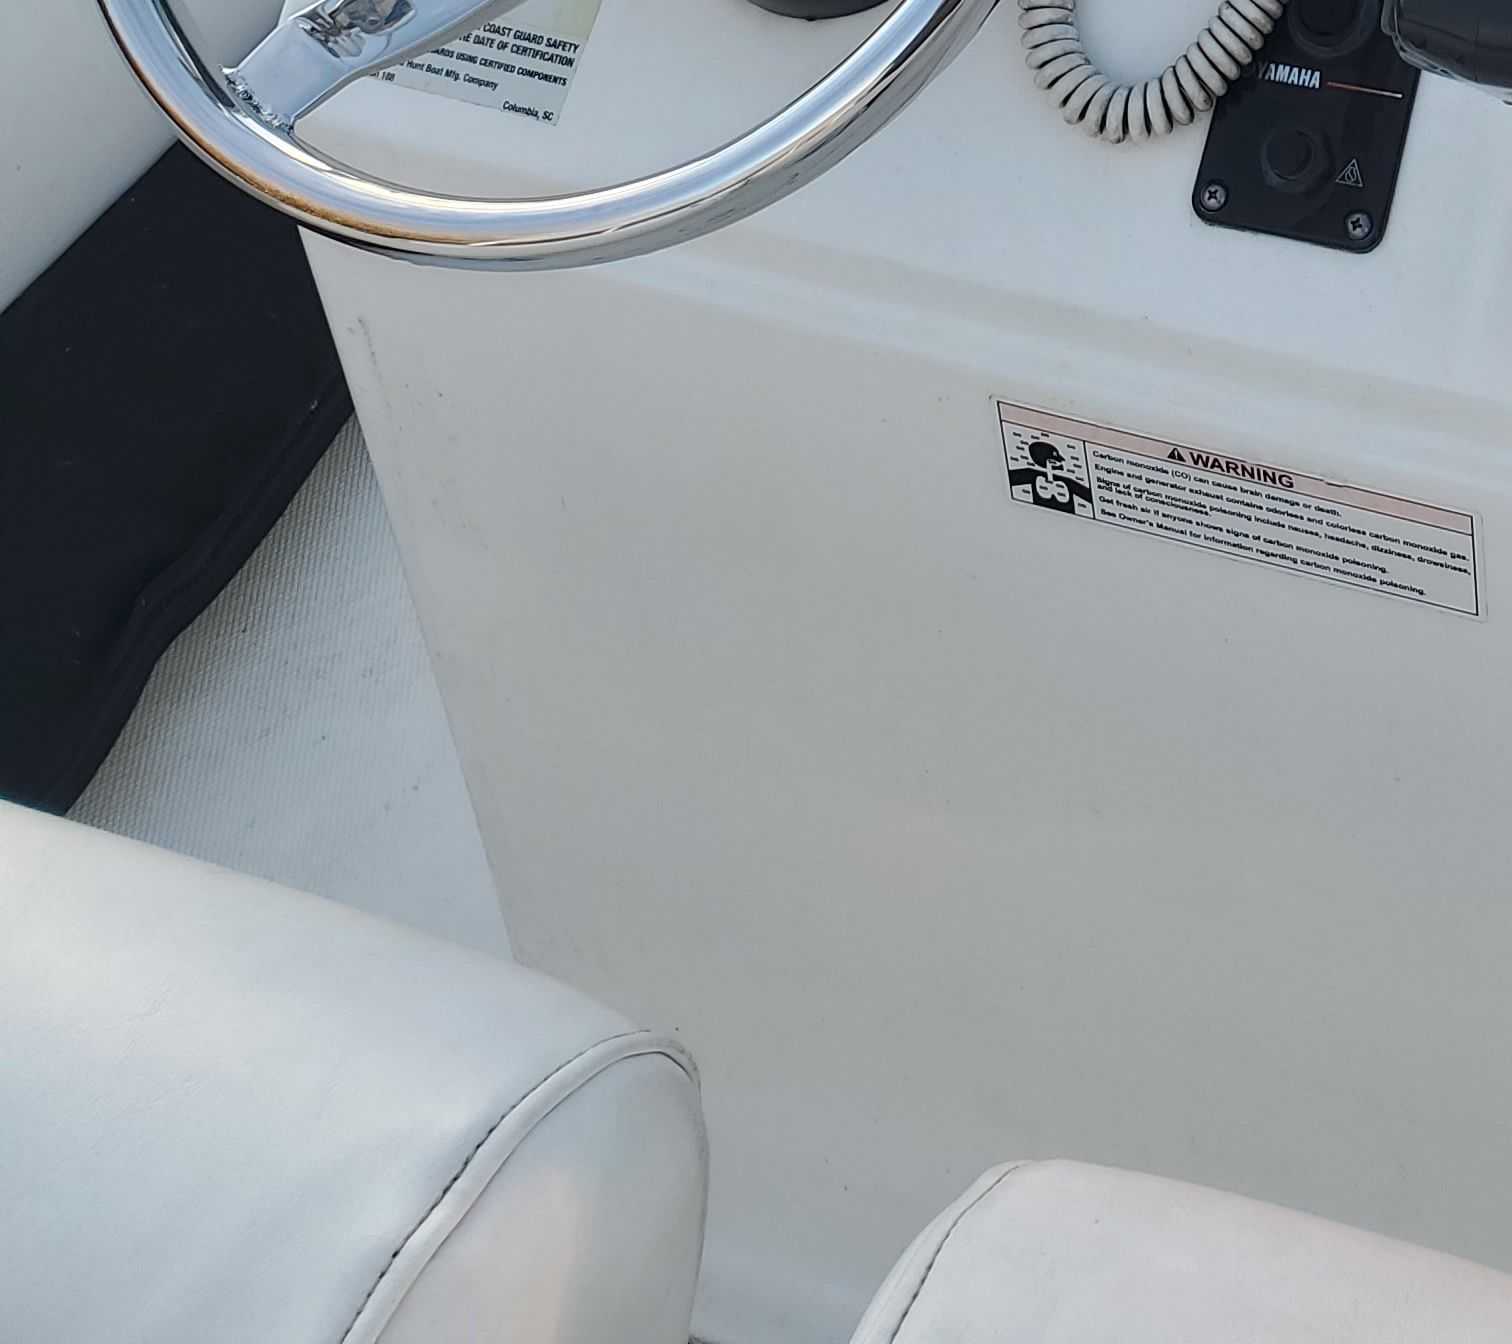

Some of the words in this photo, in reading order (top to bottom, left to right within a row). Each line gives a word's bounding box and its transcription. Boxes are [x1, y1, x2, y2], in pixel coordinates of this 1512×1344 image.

[473, 35, 495, 49] DATE
[497, 40, 508, 51] OF
[510, 44, 575, 68] CERTIFICATION
[483, 23, 513, 38] COAST
[513, 29, 543, 45] GUARD
[546, 37, 579, 54] SAFETY
[425, 64, 444, 75] Boat
[463, 74, 500, 92] Company
[456, 52, 478, 63] USING
[479, 57, 515, 73] CERTIFIED
[516, 65, 568, 86] COMPONENTS
[1258, 61, 1320, 89] YAMAHA
[502, 101, 540, 120] Columbia,
[542, 110, 554, 122] SC
[1093, 450, 1125, 464] Carbon
[1127, 460, 1169, 475] monoxide
[1171, 469, 1192, 482] (CO)
[1194, 476, 1209, 485] can
[1212, 480, 1237, 491] cause
[1265, 492, 1300, 507] damage
[1189, 451, 1294, 489] WARNING
[1095, 464, 1124, 477] Engine
[1127, 470, 1142, 481] and
[1145, 476, 1186, 492] generator
[1189, 486, 1223, 501] exhaust
[1226, 495, 1263, 511] contains
[1266, 505, 1304, 519] odorless
[1307, 514, 1323, 525] and
[1326, 520, 1366, 536] colorless
[1369, 530, 1400, 544] carbon
[1403, 540, 1448, 556] monoxide
[1133, 485, 1162, 499] carbon
[1164, 494, 1207, 509] monoxide
[1209, 505, 1252, 521] poisoning
[1118, 512, 1153, 527] Owner's
[1156, 522, 1187, 535] Manual
[1189, 529, 1201, 539] for
[1204, 534, 1253, 552] information
[1255, 548, 1298, 564] regarding
[1300, 558, 1331, 572] carbon
[1333, 567, 1377, 582] monoxide
[1161, 512, 1193, 526] anyone
[1195, 519, 1223, 533] shows
[1226, 528, 1249, 539] signs
[1263, 537, 1293, 550] carbon
[1296, 545, 1340, 561] monoxide
